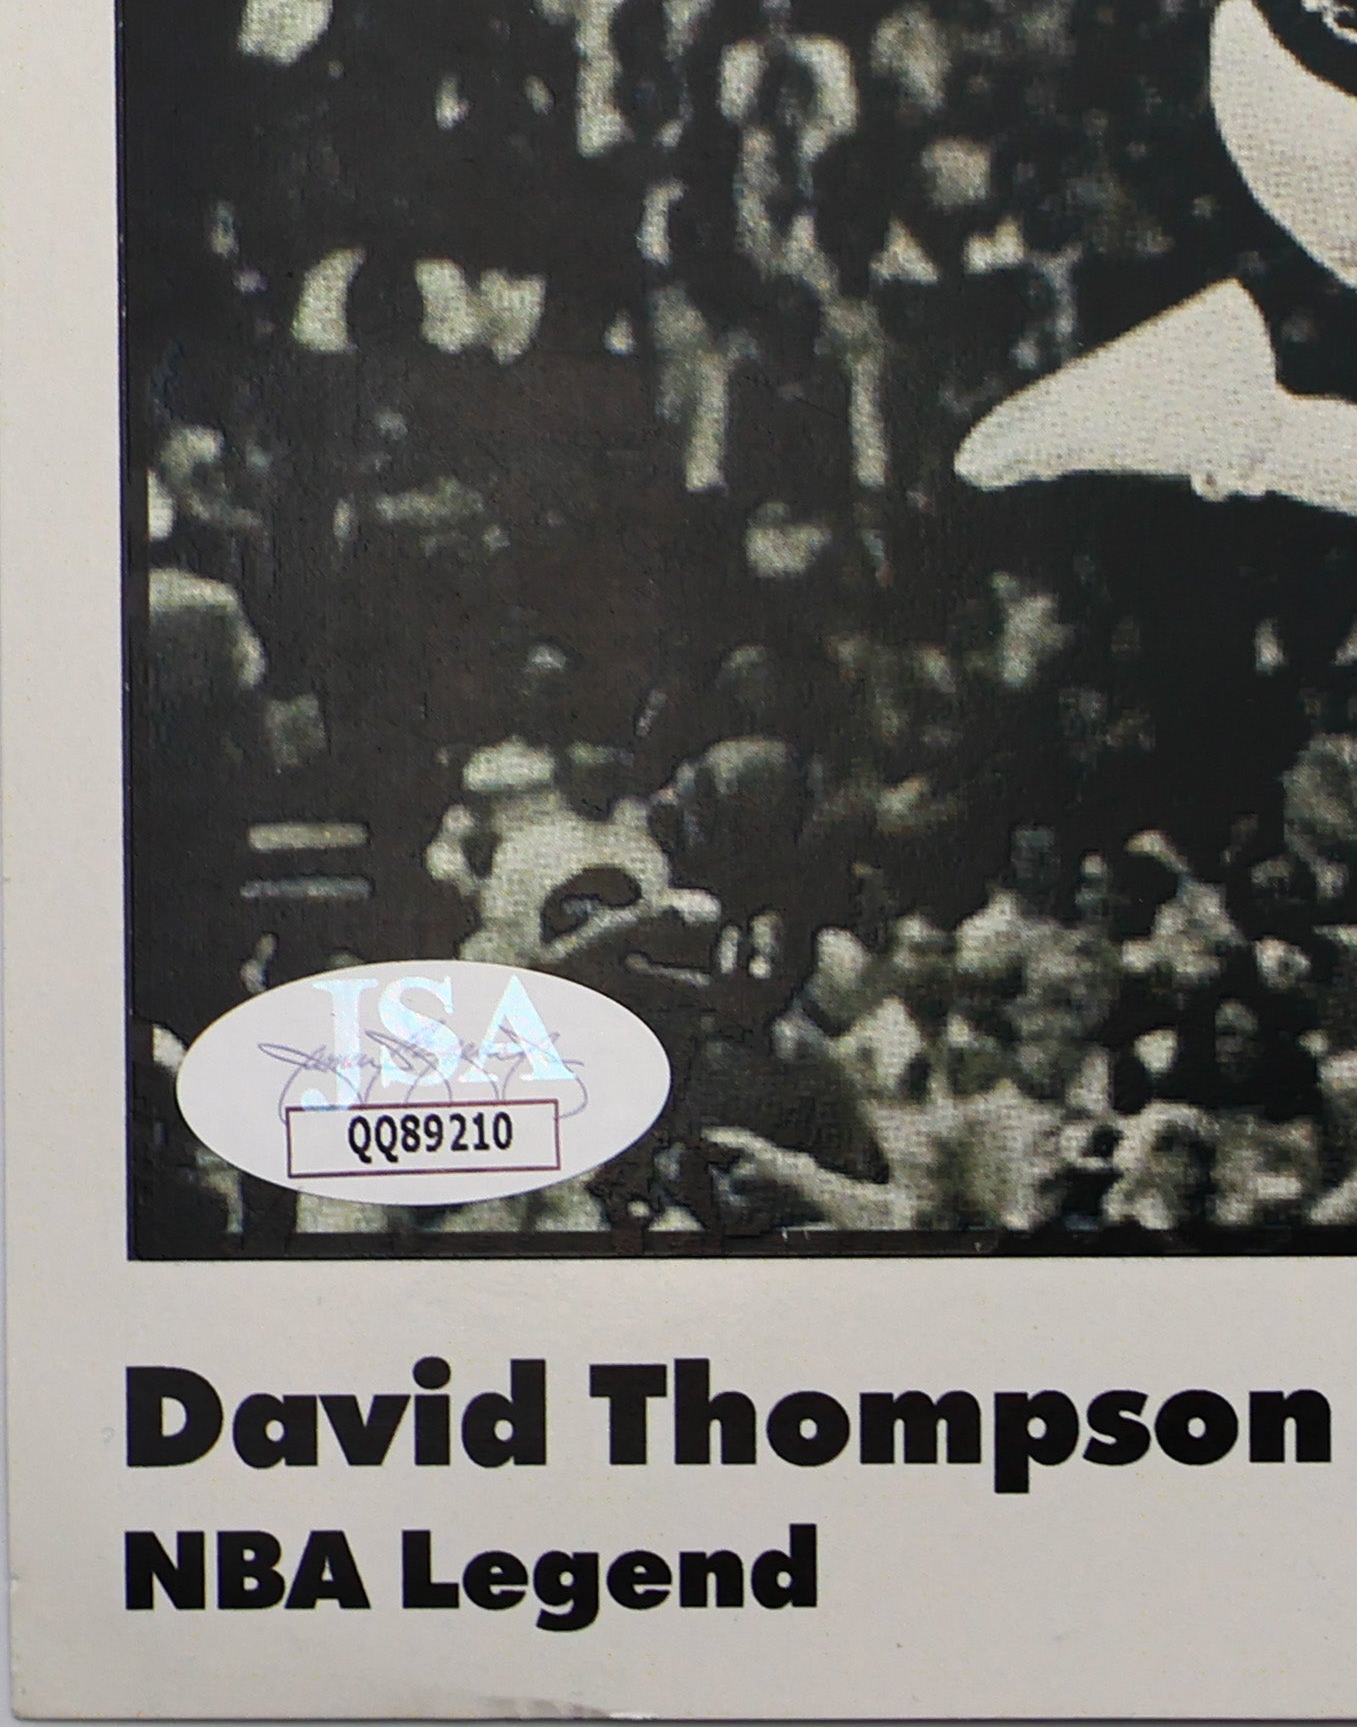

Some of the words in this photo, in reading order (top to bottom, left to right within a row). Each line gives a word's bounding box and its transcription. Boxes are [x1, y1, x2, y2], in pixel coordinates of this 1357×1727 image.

[300, 974, 577, 1112] JSA
[347, 1111, 514, 1164] QQ89210
[126, 1357, 547, 1469] David
[590, 1359, 1332, 1494] Thompson
[125, 1530, 371, 1611] NBA
[402, 1524, 818, 1632] Legend
